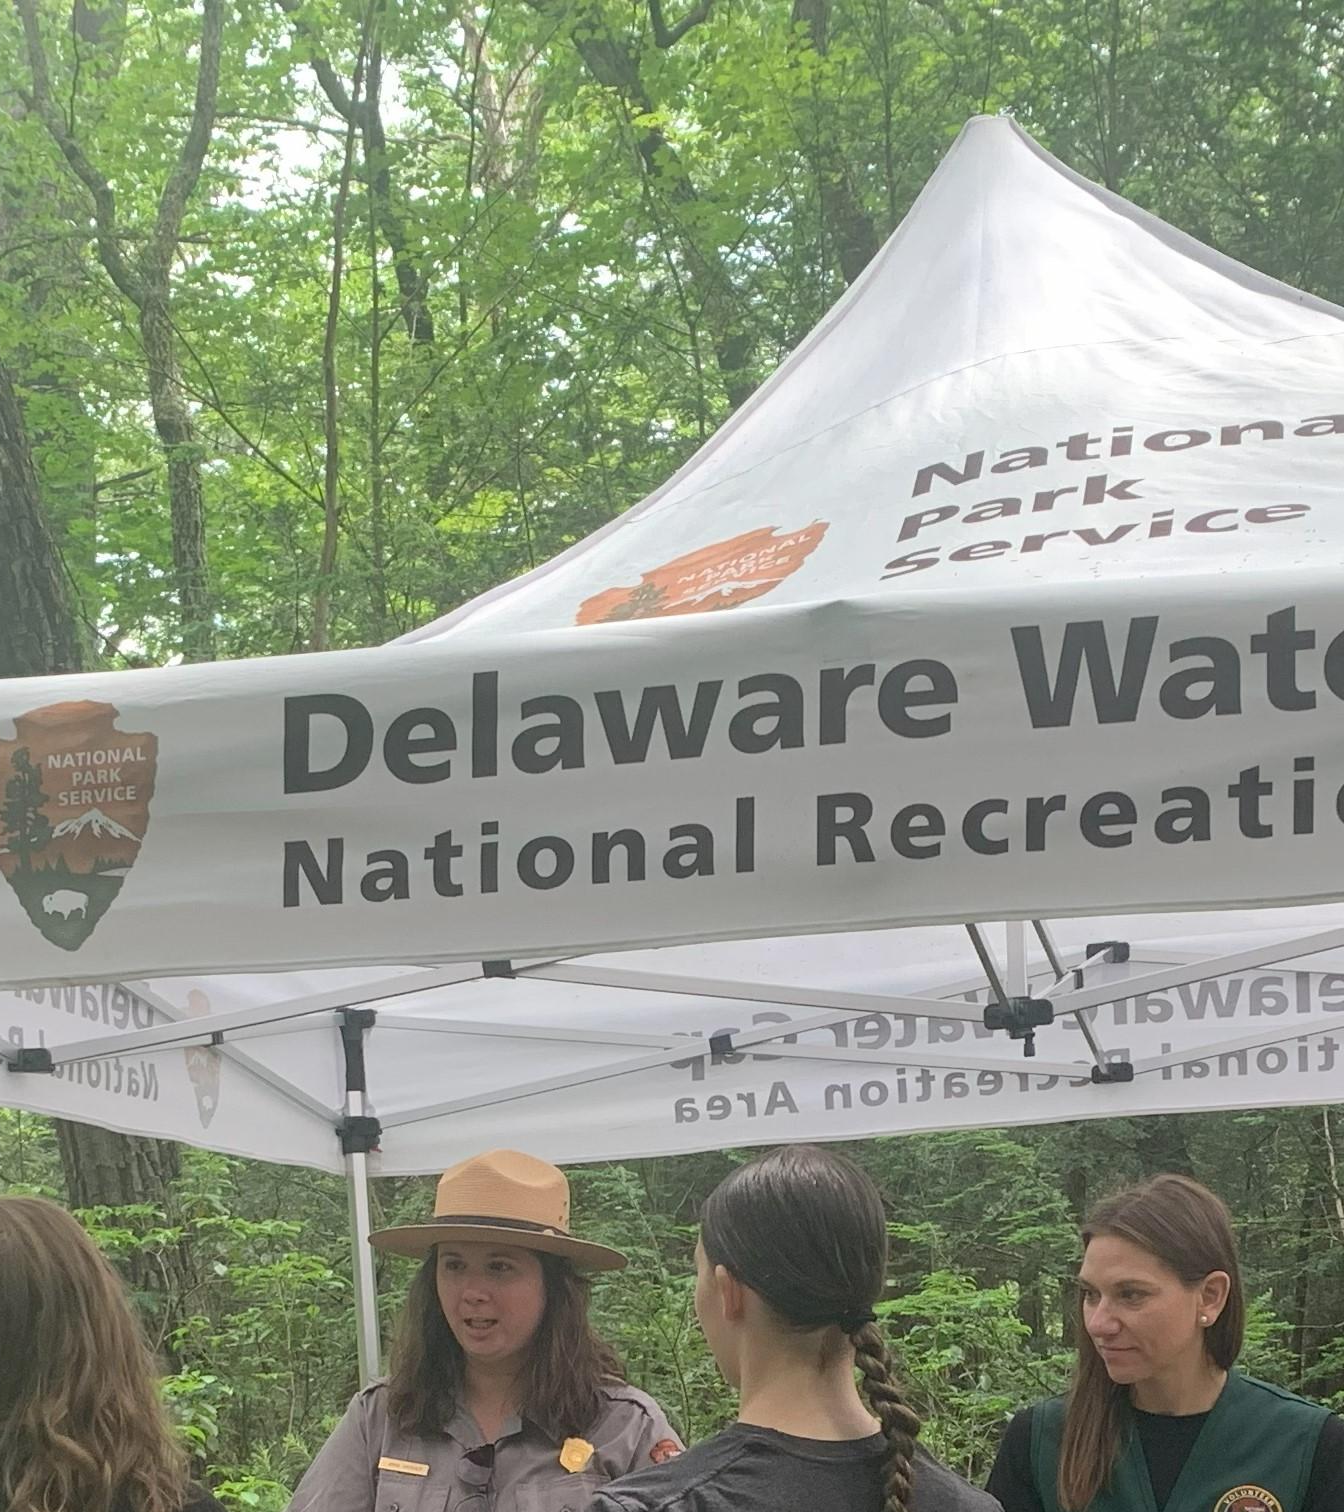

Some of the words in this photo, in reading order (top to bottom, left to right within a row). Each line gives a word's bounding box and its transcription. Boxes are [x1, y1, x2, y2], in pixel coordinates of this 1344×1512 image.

[879, 502, 1312, 580] Service
[896, 474, 1146, 542] Park
[47, 747, 146, 769] NATIONAL
[283, 659, 958, 794] Delaware
[58, 786, 137, 807] SERVICE
[72, 768, 121, 787] PARK
[282, 797, 756, 908] National
